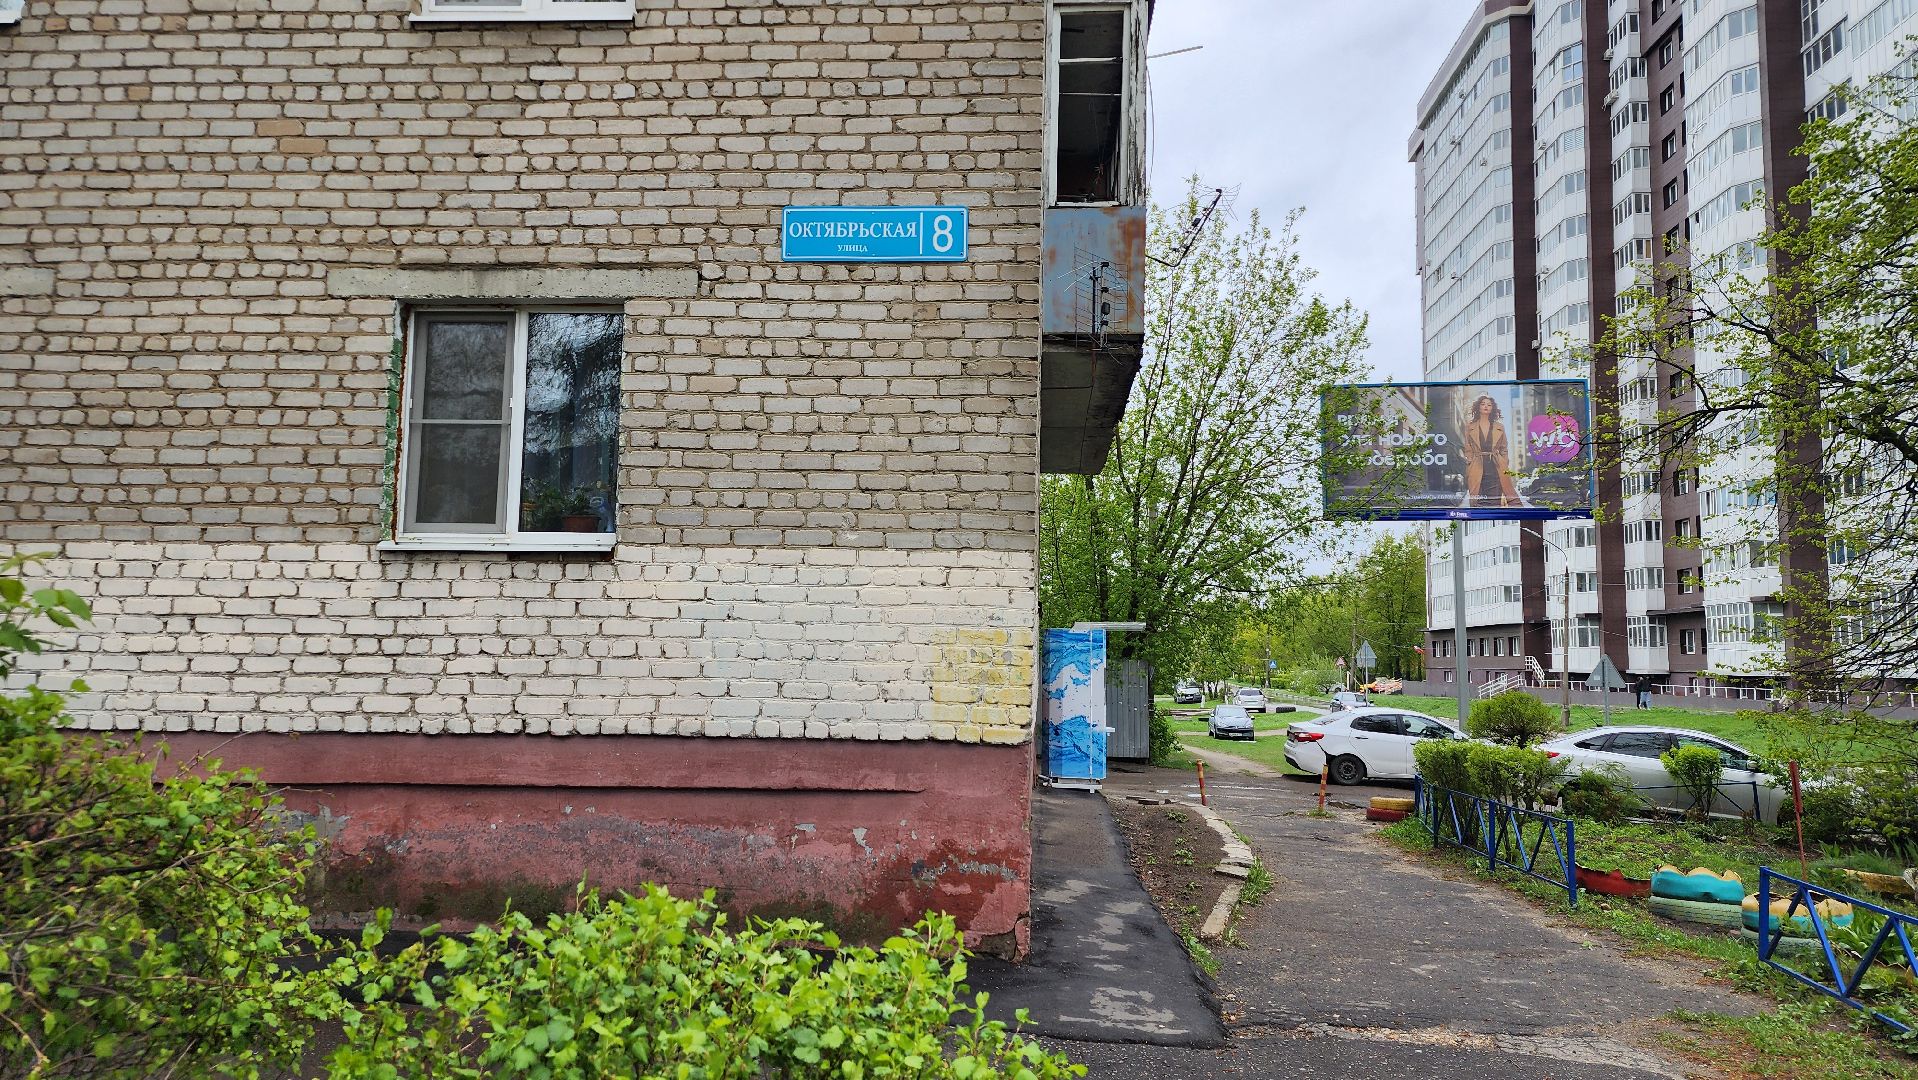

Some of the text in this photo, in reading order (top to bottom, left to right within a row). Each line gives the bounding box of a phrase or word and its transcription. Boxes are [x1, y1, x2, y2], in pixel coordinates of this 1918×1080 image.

[789, 221, 917, 238] ОКТЯБРЬСКАЯ
[932, 214, 954, 253] 8
[837, 244, 868, 253] УЛИЦА
[1378, 432, 1448, 446] нового
[1338, 449, 1448, 468] дероба
